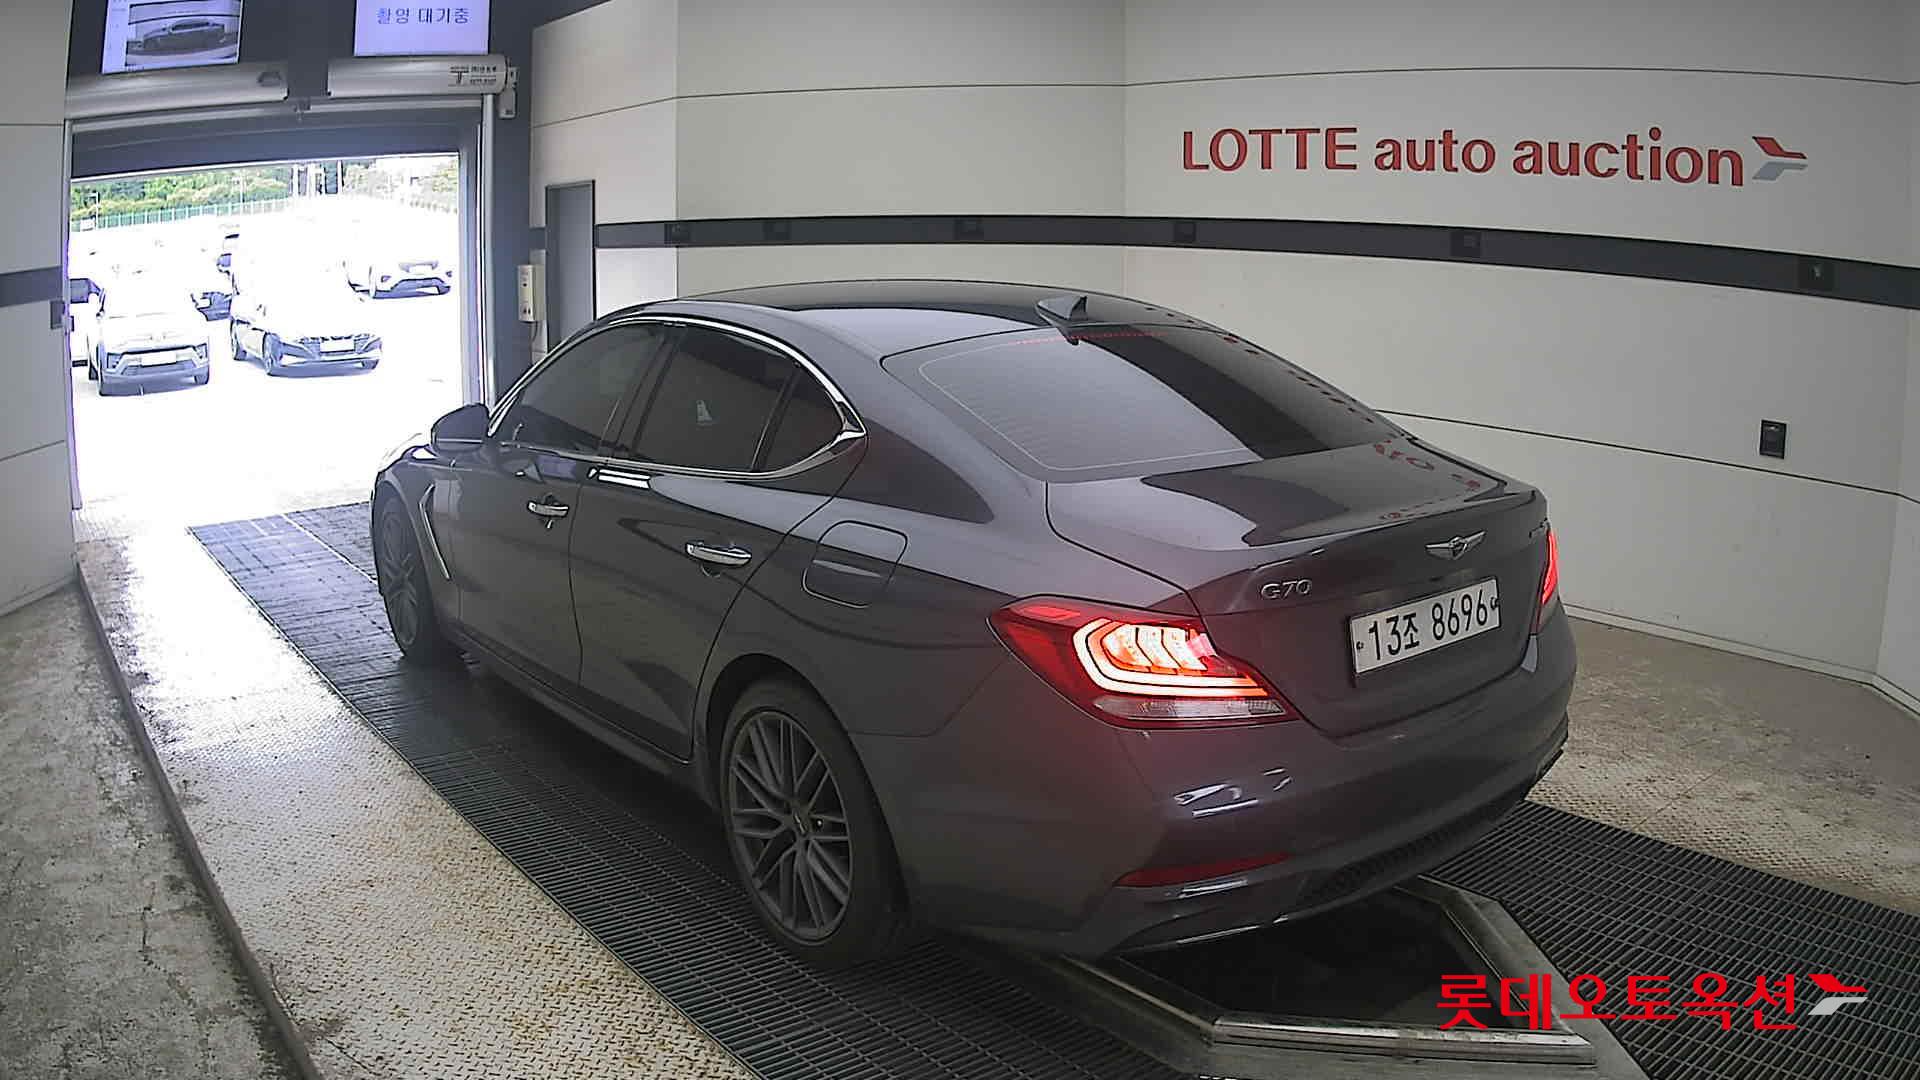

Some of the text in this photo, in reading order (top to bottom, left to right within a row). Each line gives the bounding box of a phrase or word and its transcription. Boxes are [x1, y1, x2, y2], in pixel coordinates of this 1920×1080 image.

[418, 7, 469, 24] 대기중
[1183, 126, 1744, 187] LOTTE auto auction
[1260, 579, 1312, 599] G70
[1368, 589, 1488, 661] 13조 8696
